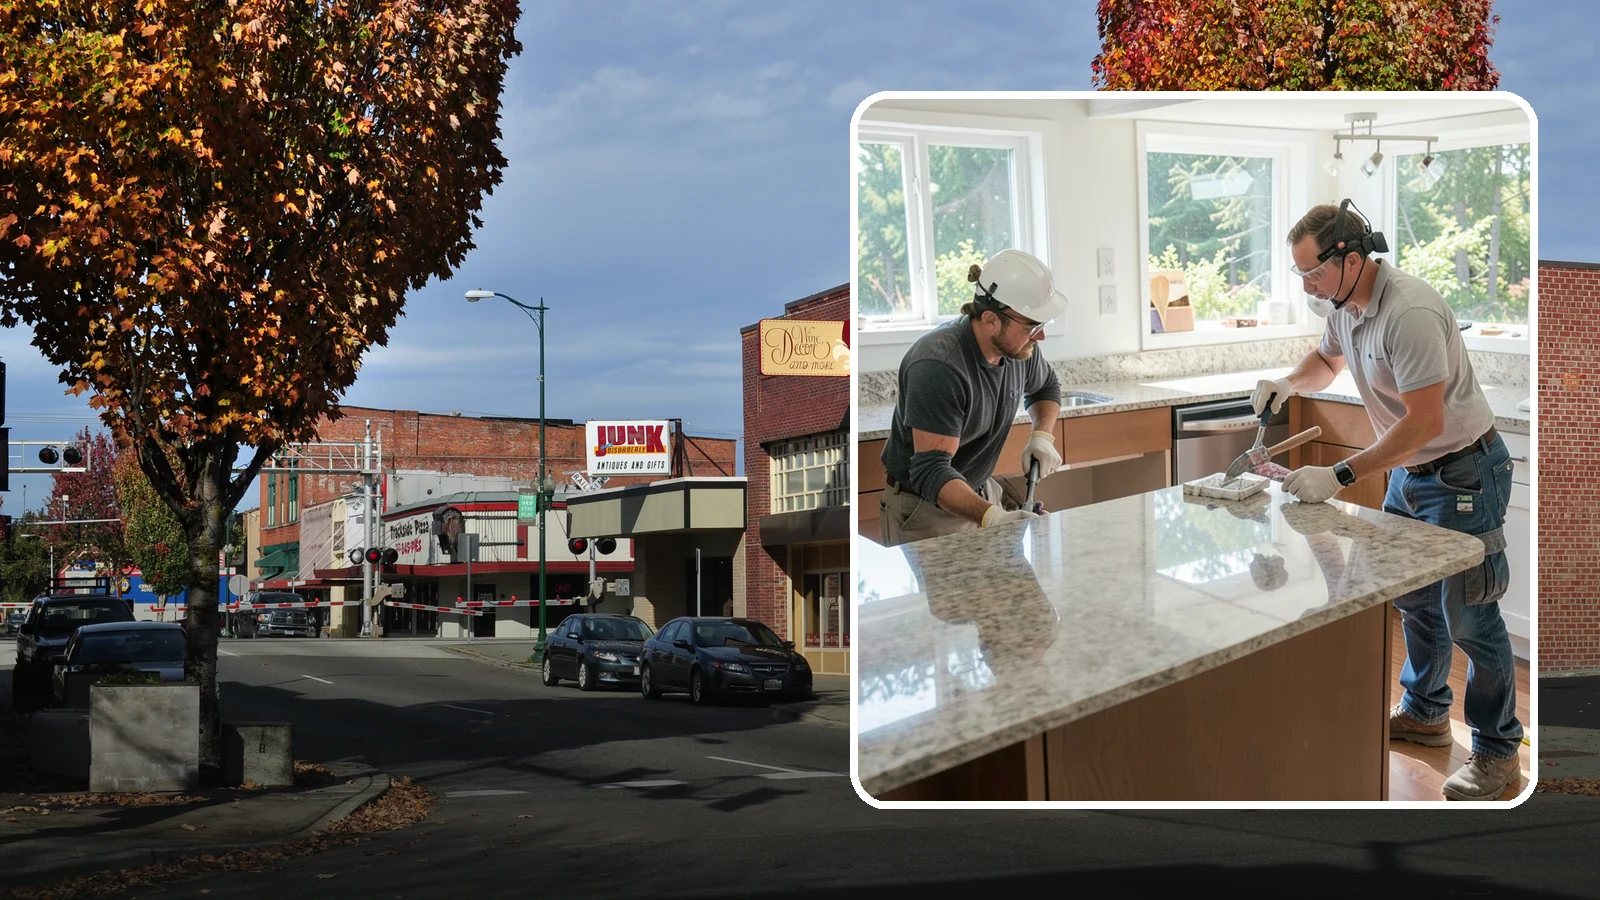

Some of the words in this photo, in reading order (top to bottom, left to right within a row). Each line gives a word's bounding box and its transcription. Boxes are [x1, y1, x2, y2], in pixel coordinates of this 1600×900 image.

[595, 425, 664, 457] JUNK
[607, 446, 646, 454] DISORDERLY
[596, 460, 628, 470] ANTIQUES
[631, 460, 644, 470] AND
[647, 460, 666, 470] GIFTS
[390, 521, 413, 540] Trackside
[414, 519, 429, 535] Pizza
